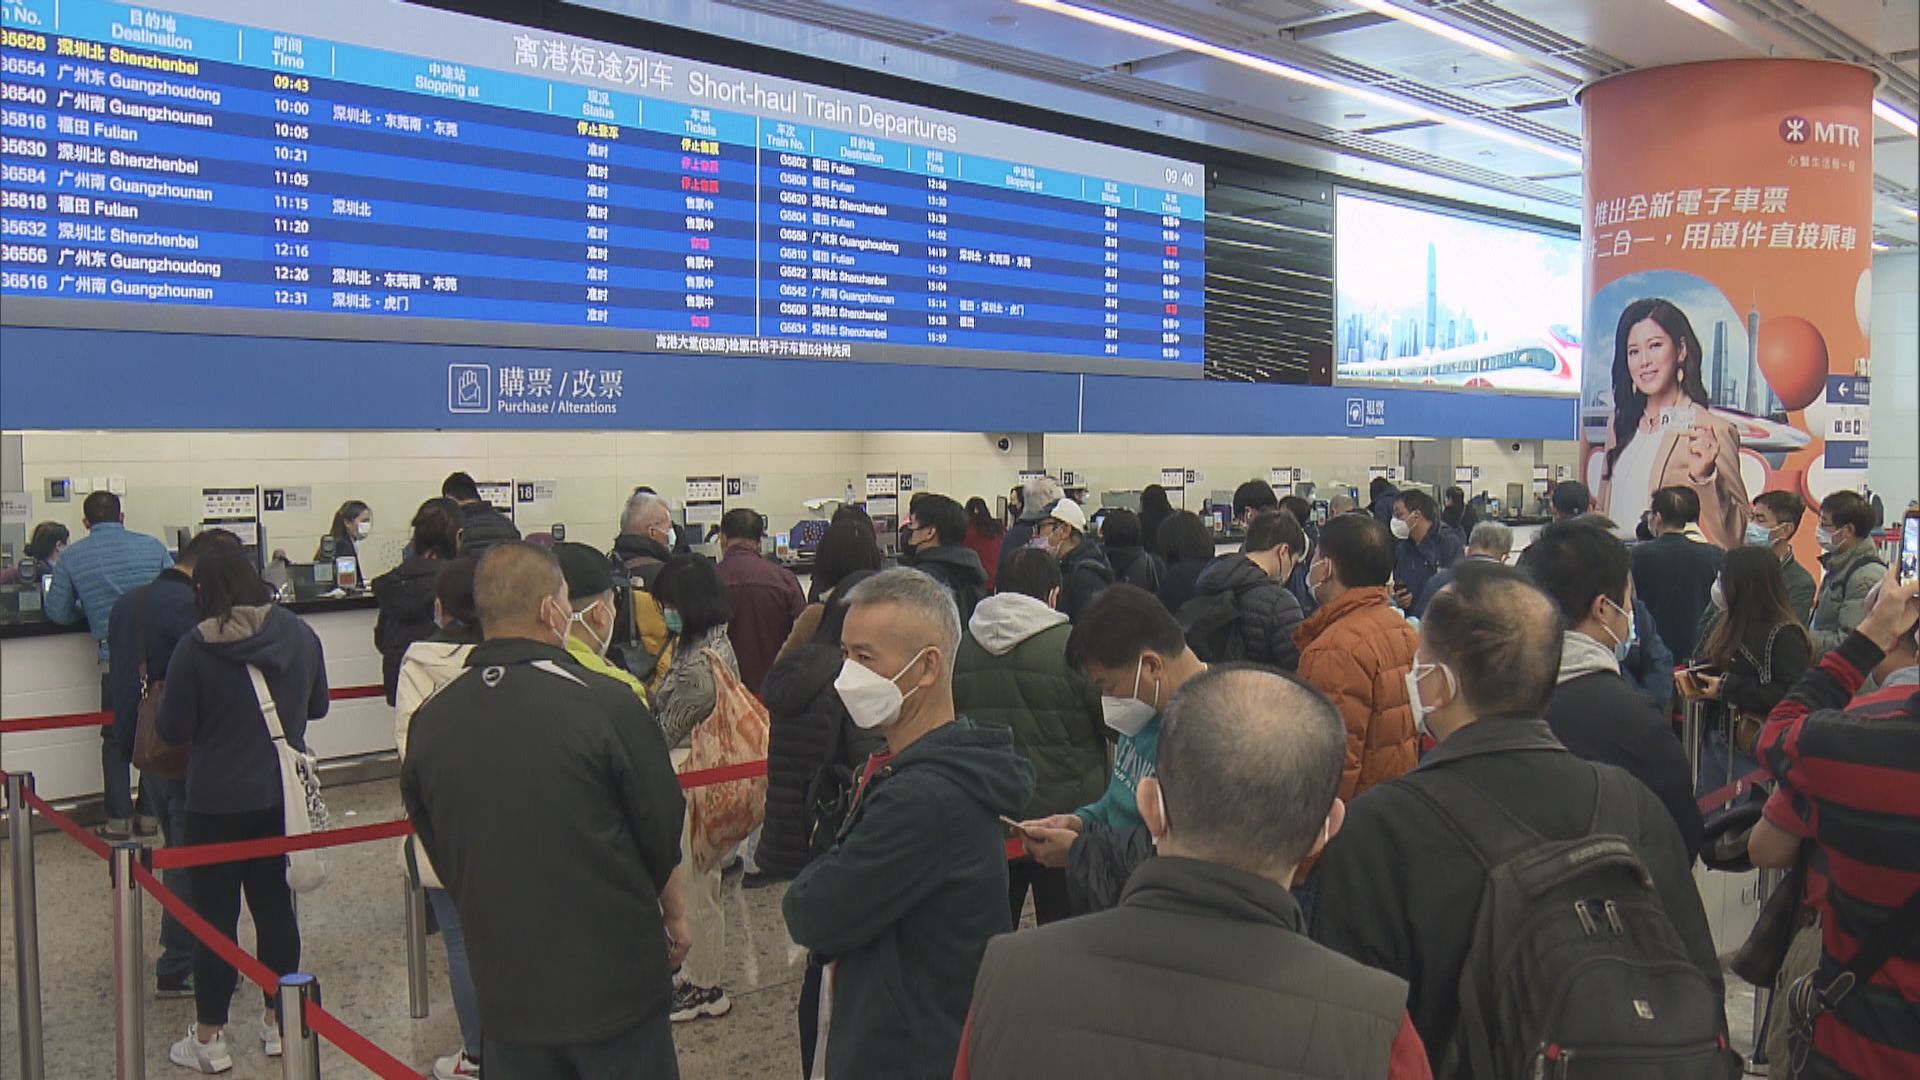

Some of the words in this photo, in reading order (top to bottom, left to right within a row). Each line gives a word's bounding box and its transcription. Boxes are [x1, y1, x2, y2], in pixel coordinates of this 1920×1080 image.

[111, 20, 193, 51] Destination
[130, 9, 177, 34] 目的地
[109, 46, 199, 75] Shenzhenbei
[273, 74, 309, 93] 09:43
[271, 50, 305, 69] Time
[109, 72, 221, 105] Guangzhoudong
[274, 98, 309, 116] 10:00
[513, 33, 674, 92] 离港短途列车
[686, 71, 797, 115] Short-haul
[803, 92, 852, 124] Train
[858, 103, 957, 144] Departures
[109, 98, 213, 127] Guangzhounan
[274, 123, 309, 140] 10:05
[93, 122, 138, 141] Futian
[274, 146, 307, 162] 10:21
[1814, 121, 1860, 148] MTR
[109, 149, 199, 175] Shenzhenbei
[274, 170, 309, 187] 11:05
[1165, 167, 1178, 184] 09
[109, 176, 213, 201] Guangzhounan
[274, 195, 309, 211] 11:15
[1593, 185, 1790, 229] 推出全新電子車票
[94, 200, 139, 219] Futian
[274, 218, 309, 234] 11:20
[110, 227, 199, 249] Shenzhenbei
[274, 242, 309, 258] 12:16
[110, 252, 221, 278] Guangzhoudong
[274, 266, 309, 282] 12:26
[110, 279, 213, 299] Guangzhounan
[274, 290, 308, 305] 12:31
[497, 399, 549, 413] Purchase
[557, 400, 617, 414] Alterations
[519, 486, 533, 499] 18
[728, 481, 740, 493] 19
[900, 476, 912, 489] 20
[265, 493, 282, 507] 17
